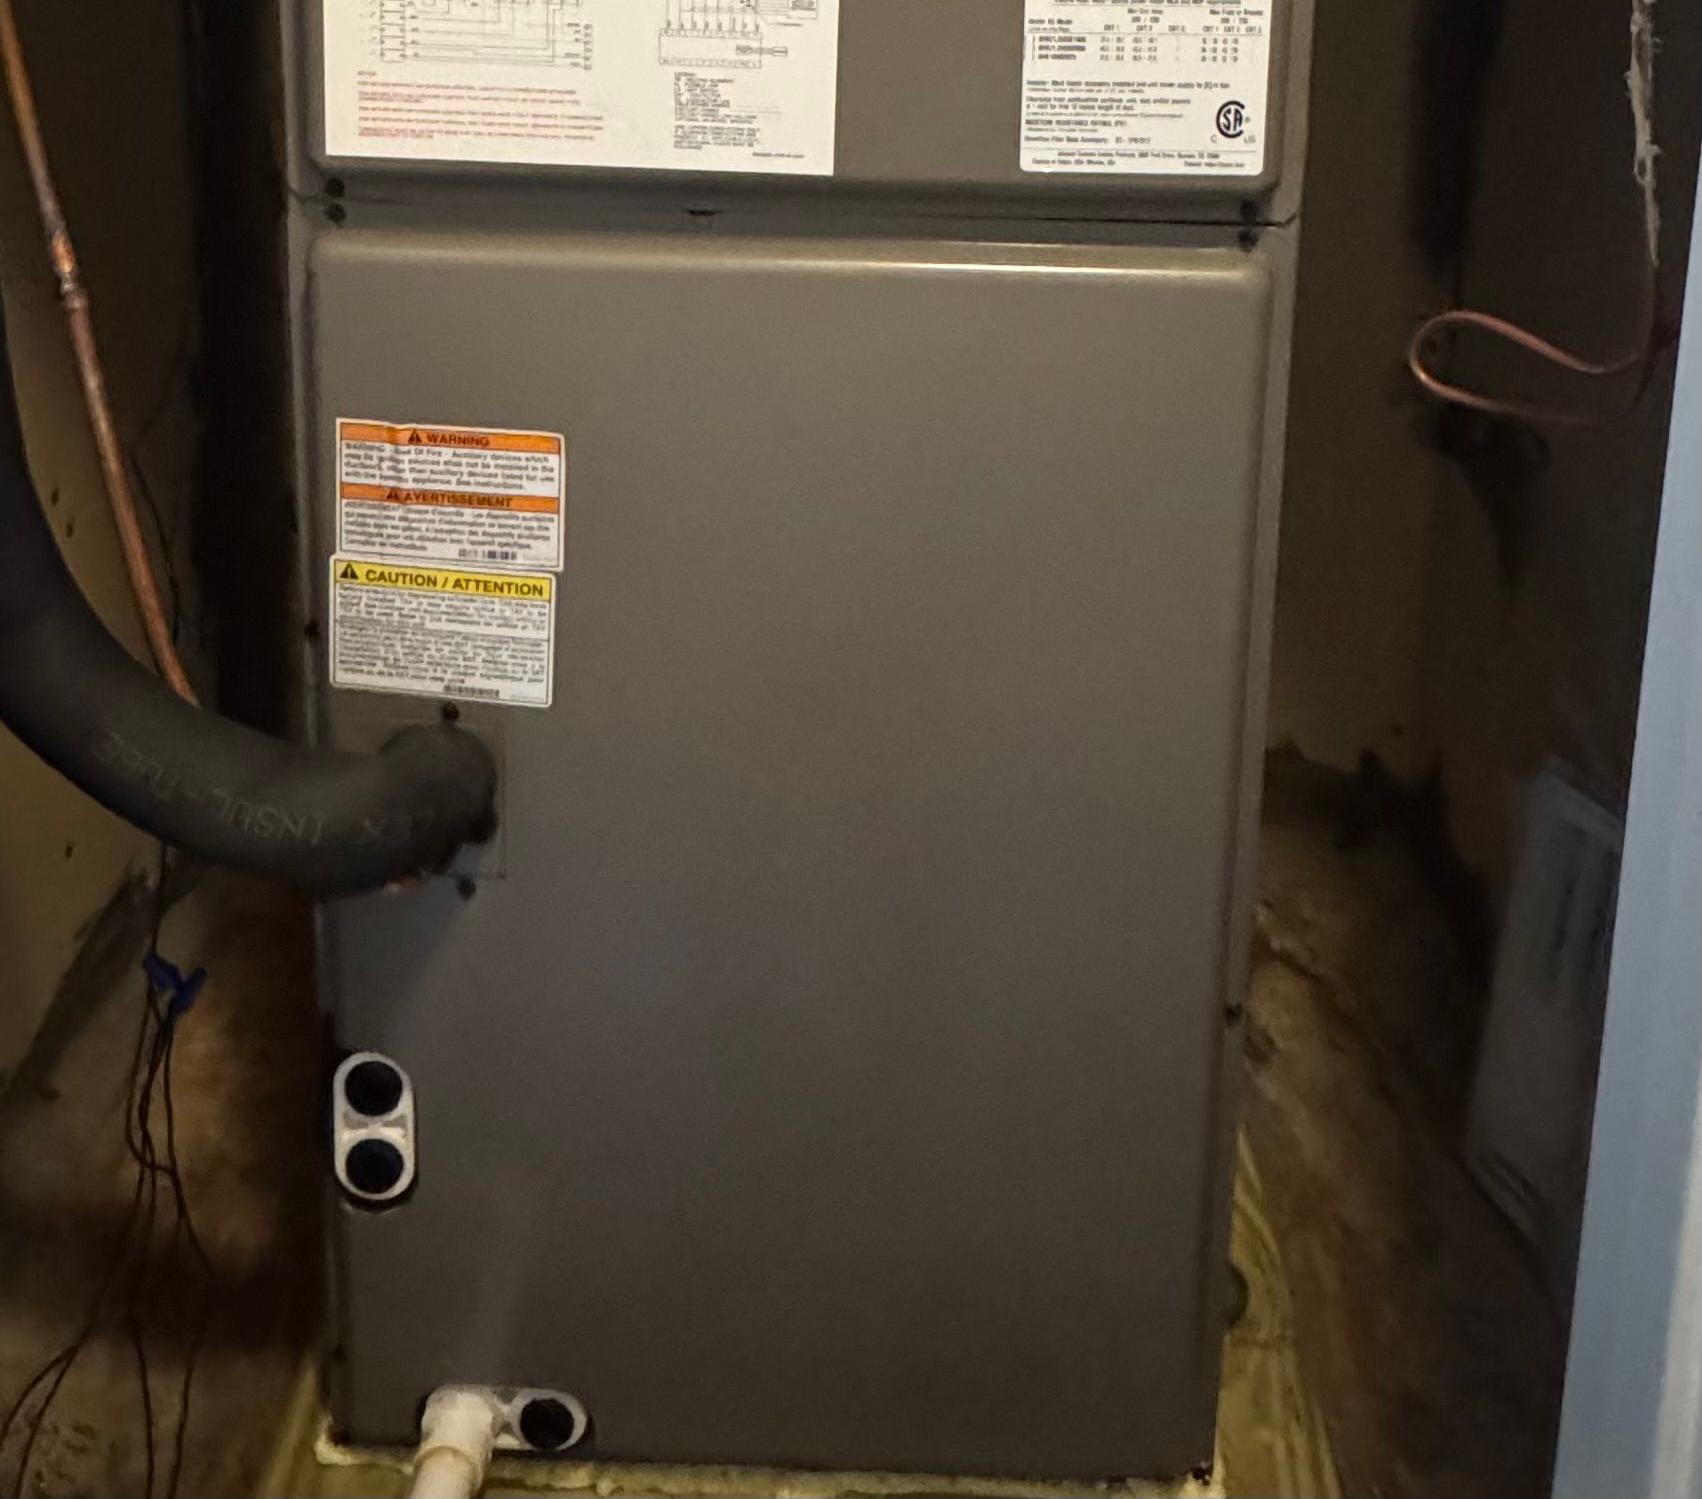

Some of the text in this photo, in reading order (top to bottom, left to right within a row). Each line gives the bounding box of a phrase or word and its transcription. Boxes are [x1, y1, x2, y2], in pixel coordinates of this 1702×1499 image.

[426, 432, 490, 447] WARNING
[404, 489, 513, 508] AVERTISSEMENT
[365, 568, 544, 597] CAUTION / ATTENTION
